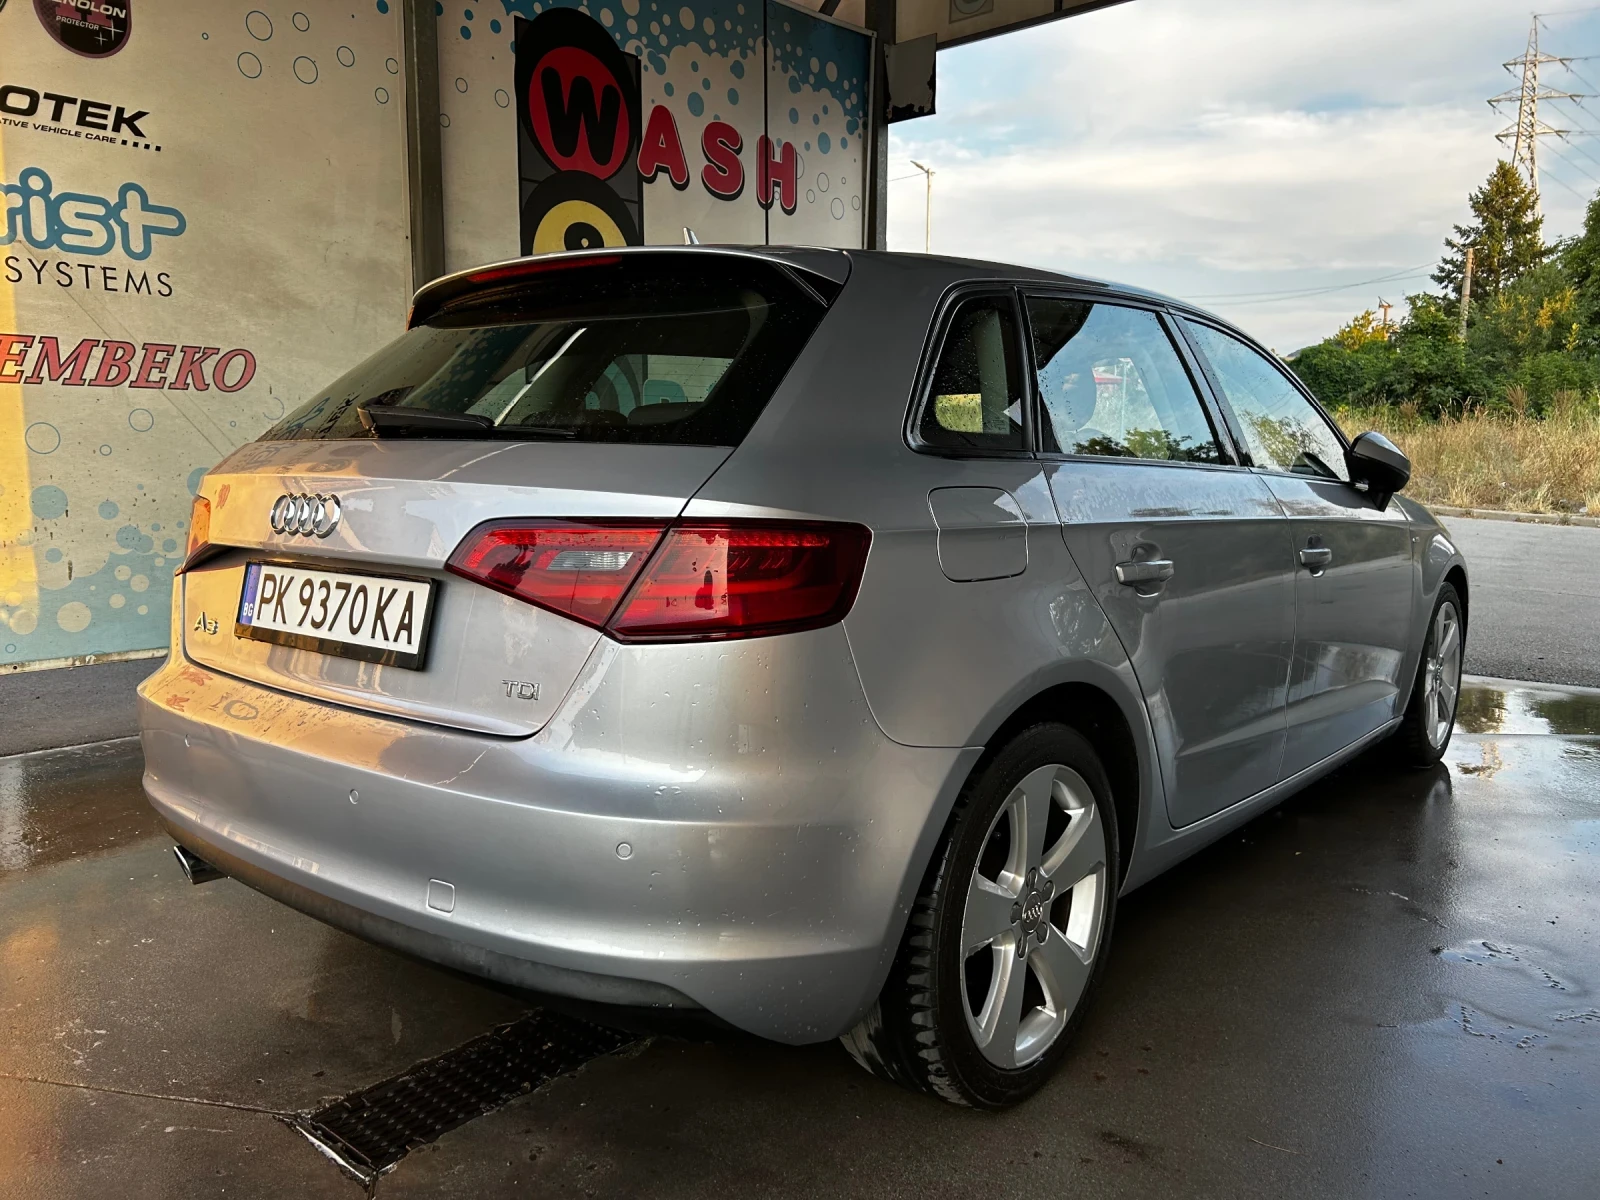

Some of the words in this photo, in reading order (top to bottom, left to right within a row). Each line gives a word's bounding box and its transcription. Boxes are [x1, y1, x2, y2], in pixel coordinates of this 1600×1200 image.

[56, 16, 99, 31] PROTECTOR
[0, 85, 150, 138] OTEK
[0, 117, 29, 129] TIVE
[33, 123, 82, 138] VEHICLE
[85, 132, 117, 144] CARE
[4, 255, 174, 297] SYSTEMS
[243, 602, 254, 616] BG
[257, 573, 295, 625] PK
[297, 578, 369, 635] 9370
[371, 586, 414, 645] KA
[194, 611, 219, 635] A3
[502, 679, 541, 701] TDI
